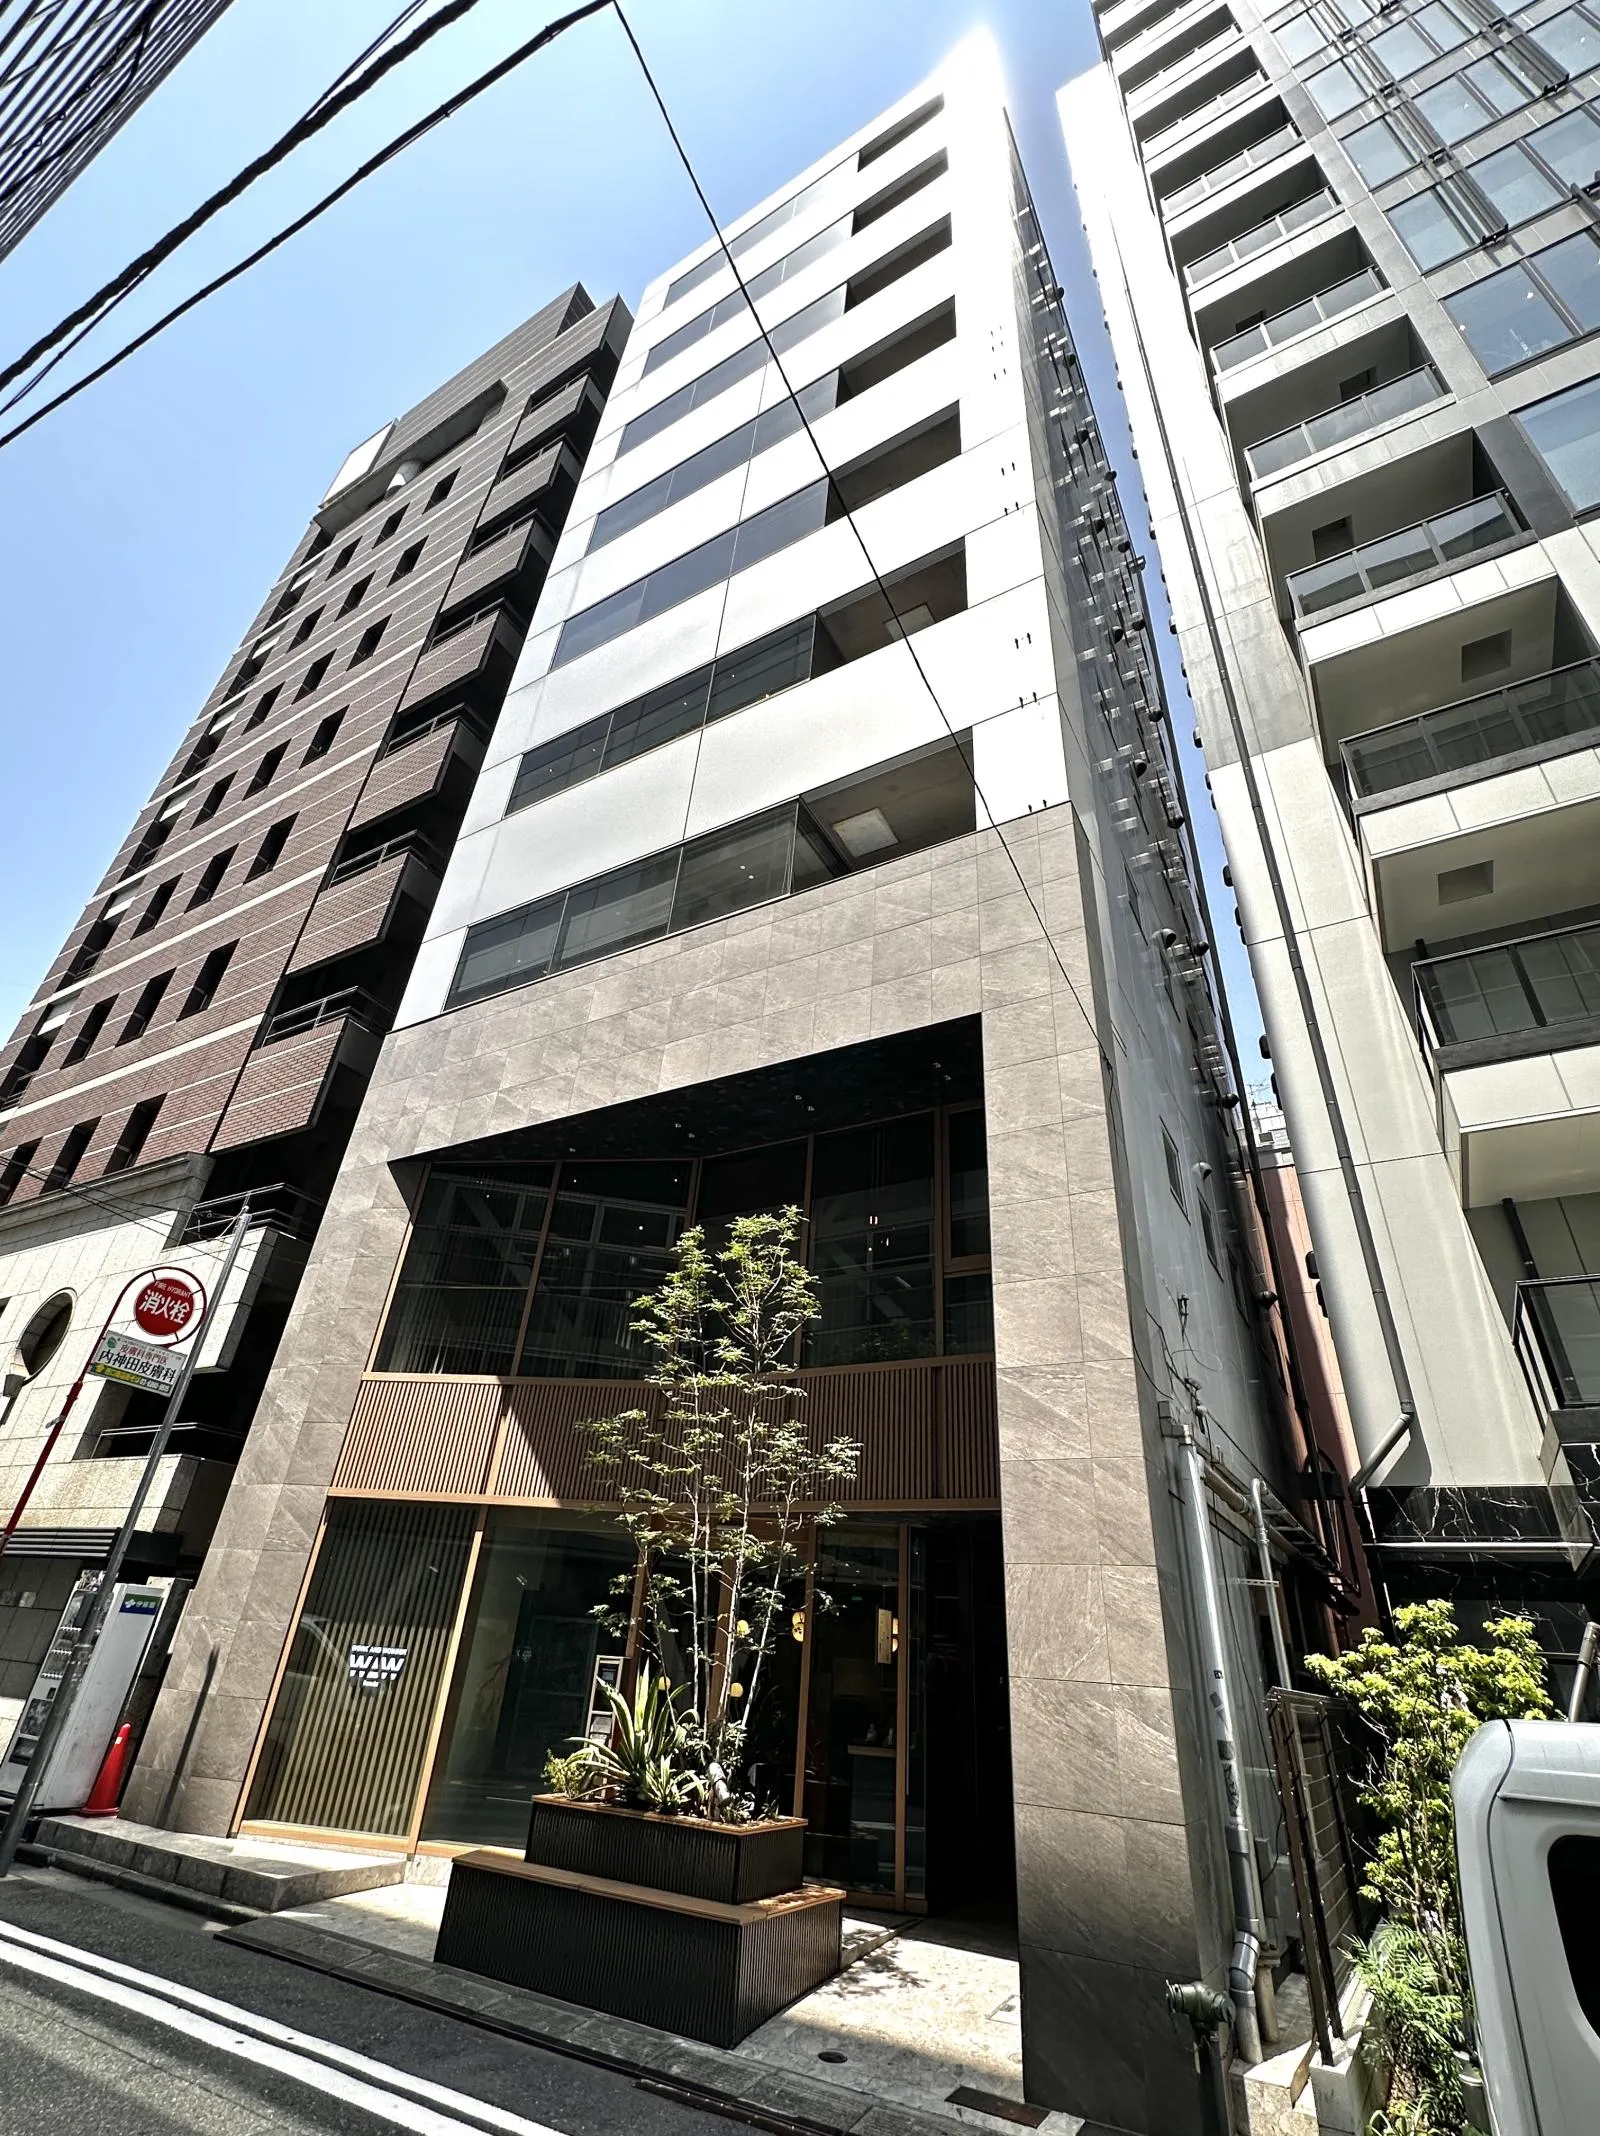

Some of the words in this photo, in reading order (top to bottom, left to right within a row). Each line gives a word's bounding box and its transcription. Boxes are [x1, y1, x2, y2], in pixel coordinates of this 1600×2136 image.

[154, 1280, 167, 1291] FIRE
[167, 1285, 192, 1298] HYDRANT
[139, 1289, 190, 1324] 消火栓
[99, 1349, 176, 1383] 内神田皮膚科
